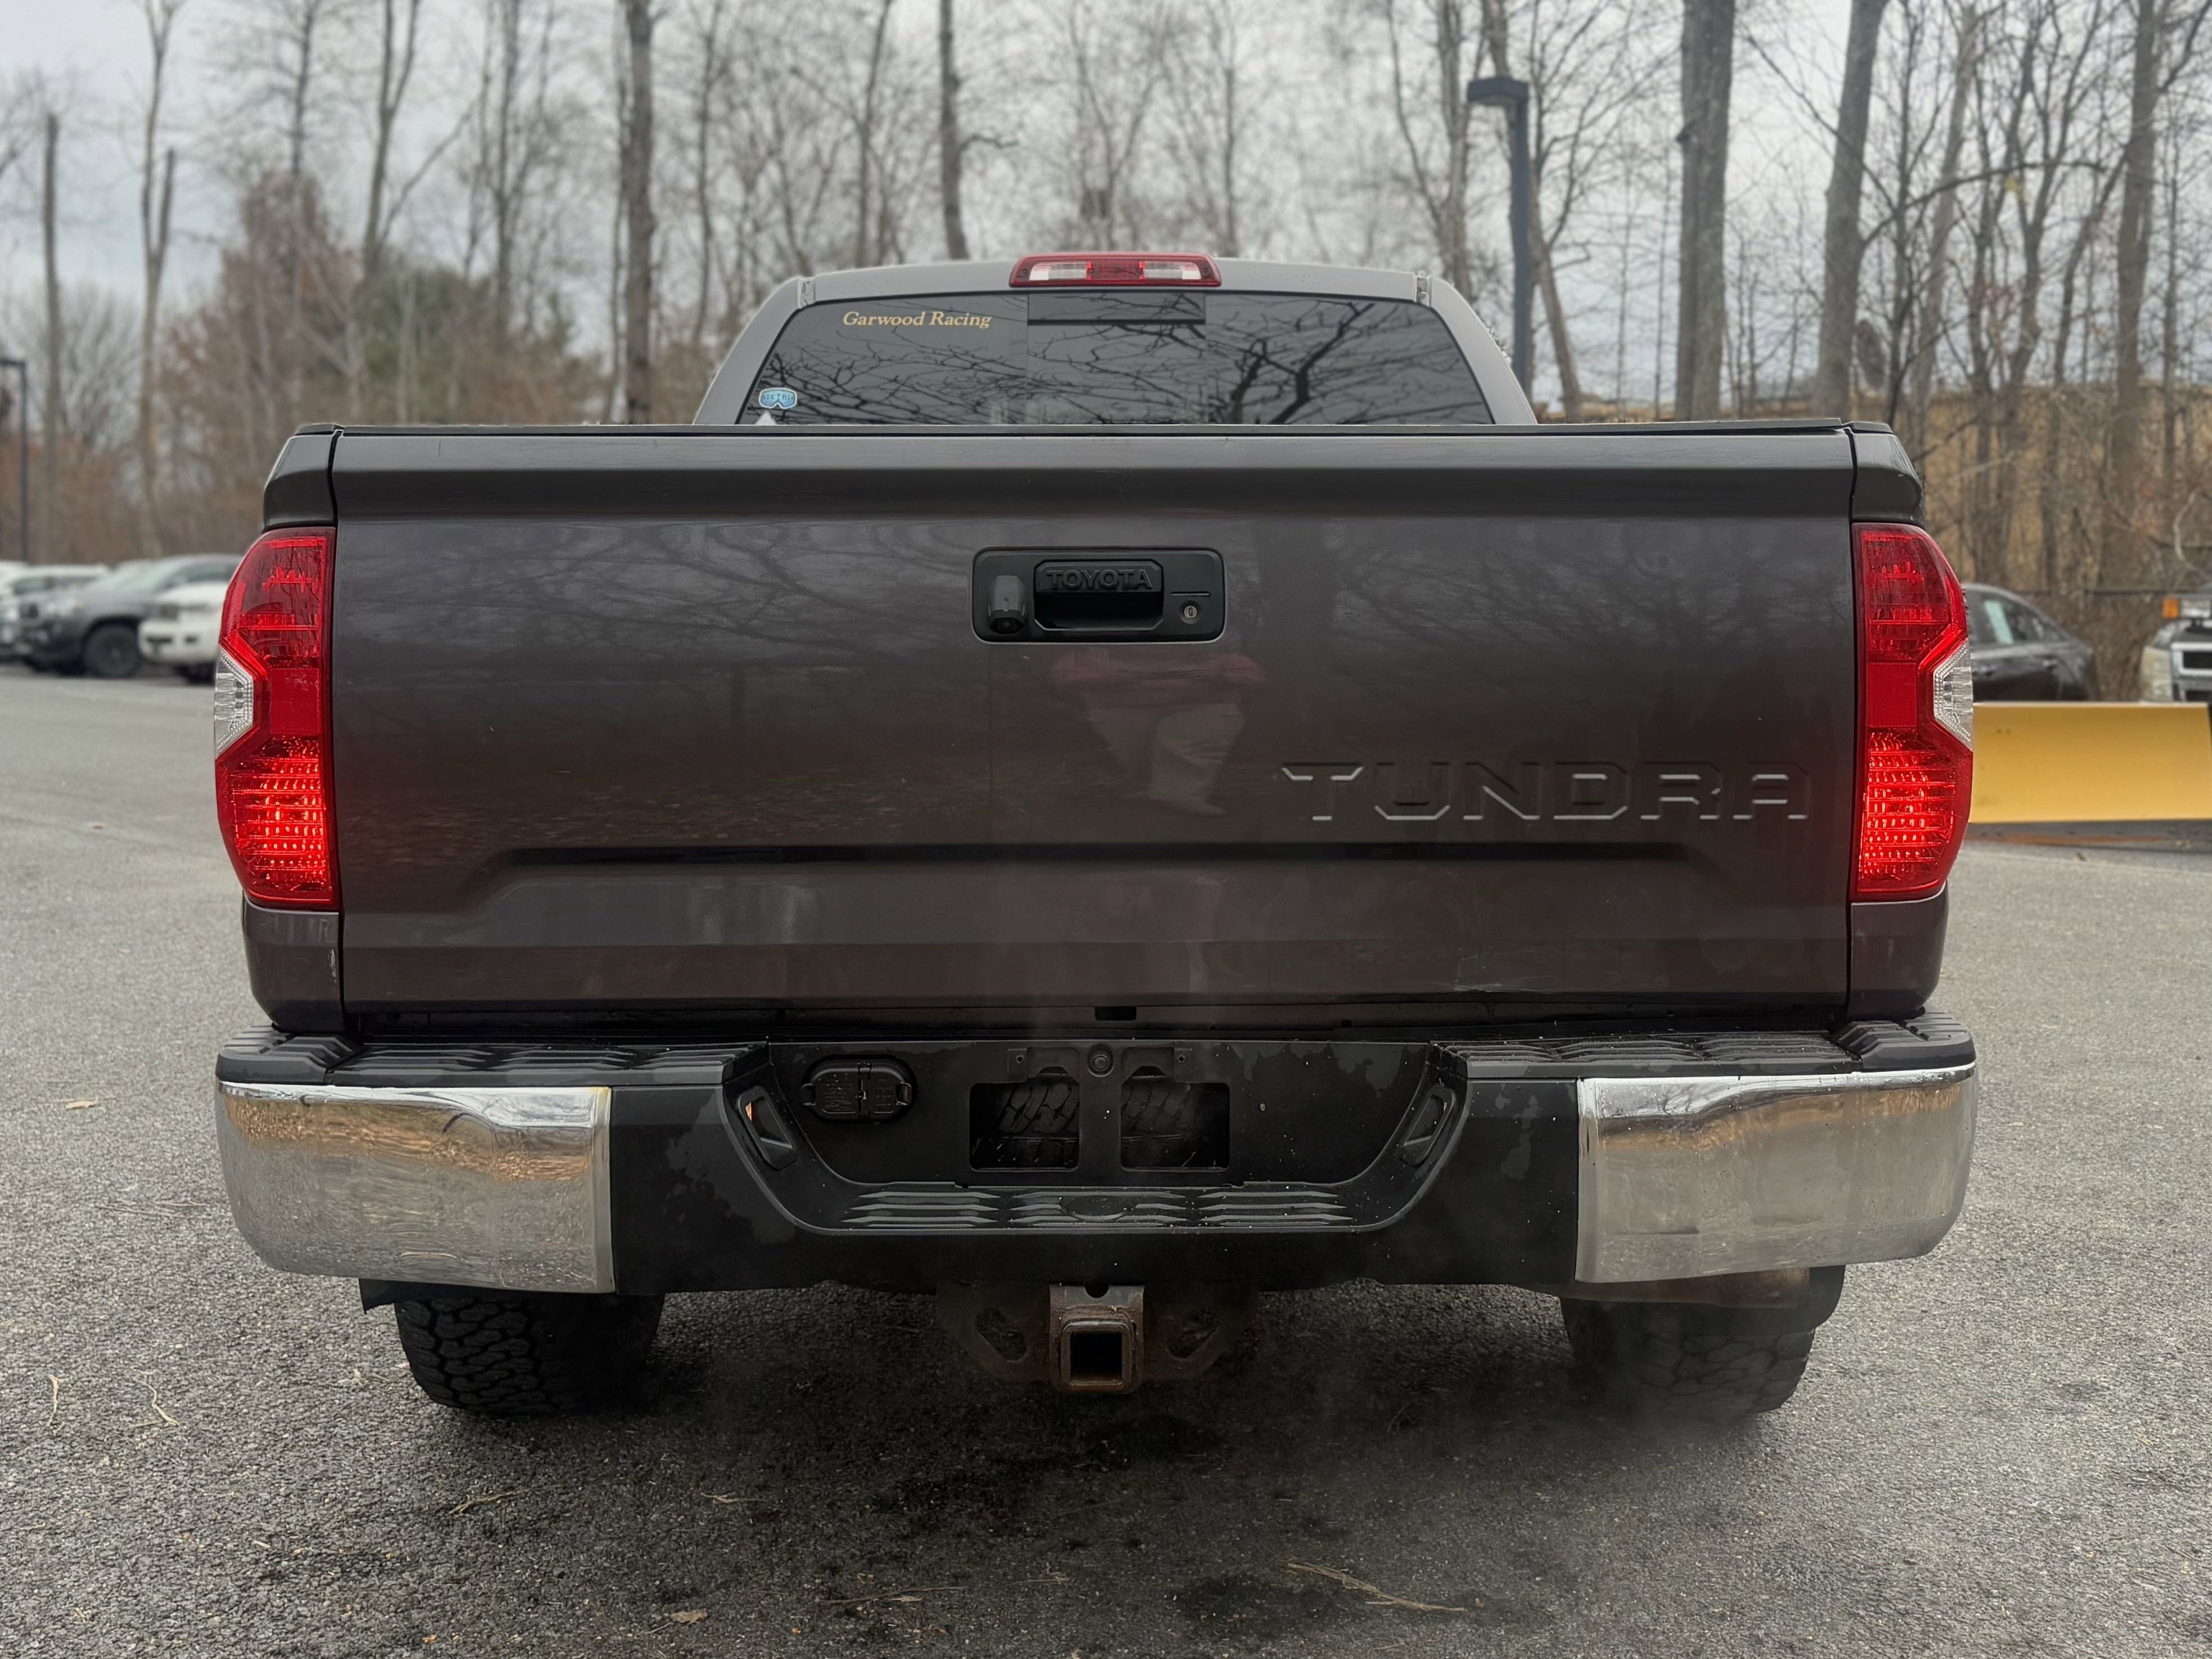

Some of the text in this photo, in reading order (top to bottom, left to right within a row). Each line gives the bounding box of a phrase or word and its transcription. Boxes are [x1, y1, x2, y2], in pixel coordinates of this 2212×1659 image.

[843, 311, 992, 328] Garwood Racing
[1046, 569, 1153, 590] TOYOTA
[1282, 762, 1809, 821] TUNDRA
